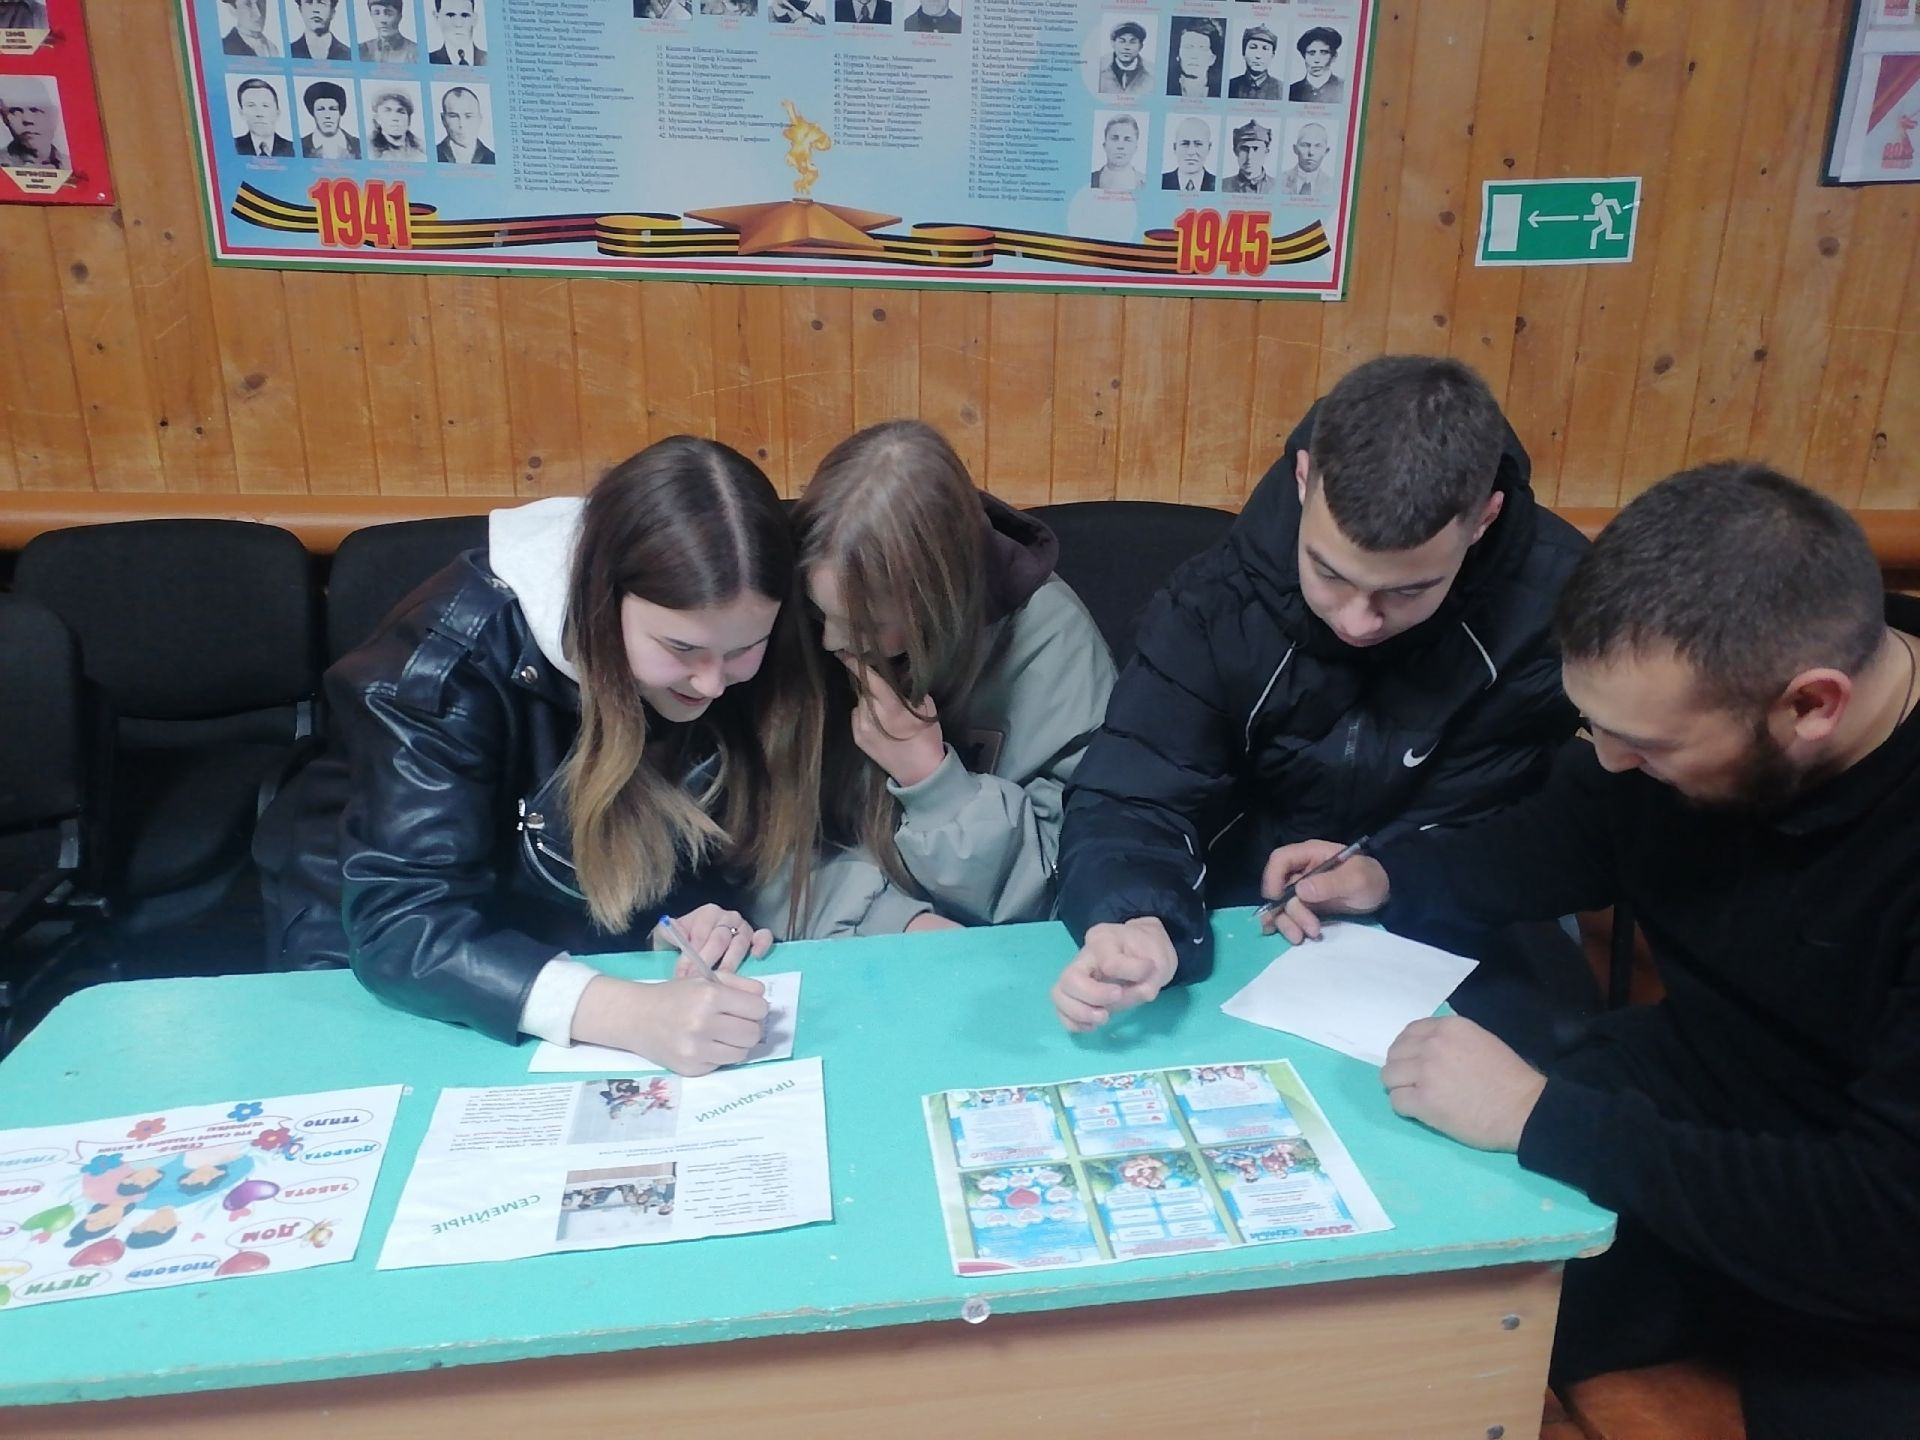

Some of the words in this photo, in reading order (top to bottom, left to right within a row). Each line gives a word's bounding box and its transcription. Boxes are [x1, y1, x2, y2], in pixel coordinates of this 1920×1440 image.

[309, 178, 411, 248] 1941
[1175, 209, 1272, 276] 1945
[695, 1079, 796, 1123] ПРАЗДНИКИ
[303, 1115, 360, 1128] ТЕПЛО
[305, 1144, 377, 1160] ДОБРОТА
[285, 1183, 349, 1198] ЗАБОТА
[432, 1195, 541, 1235] СЕМЕЙНЫЕ
[240, 1222, 300, 1243] ДОМ
[1303, 1225, 1354, 1237] 2024
[128, 1260, 218, 1279] ЛЮБОВЬ
[24, 1272, 101, 1296] ДЕТИ
